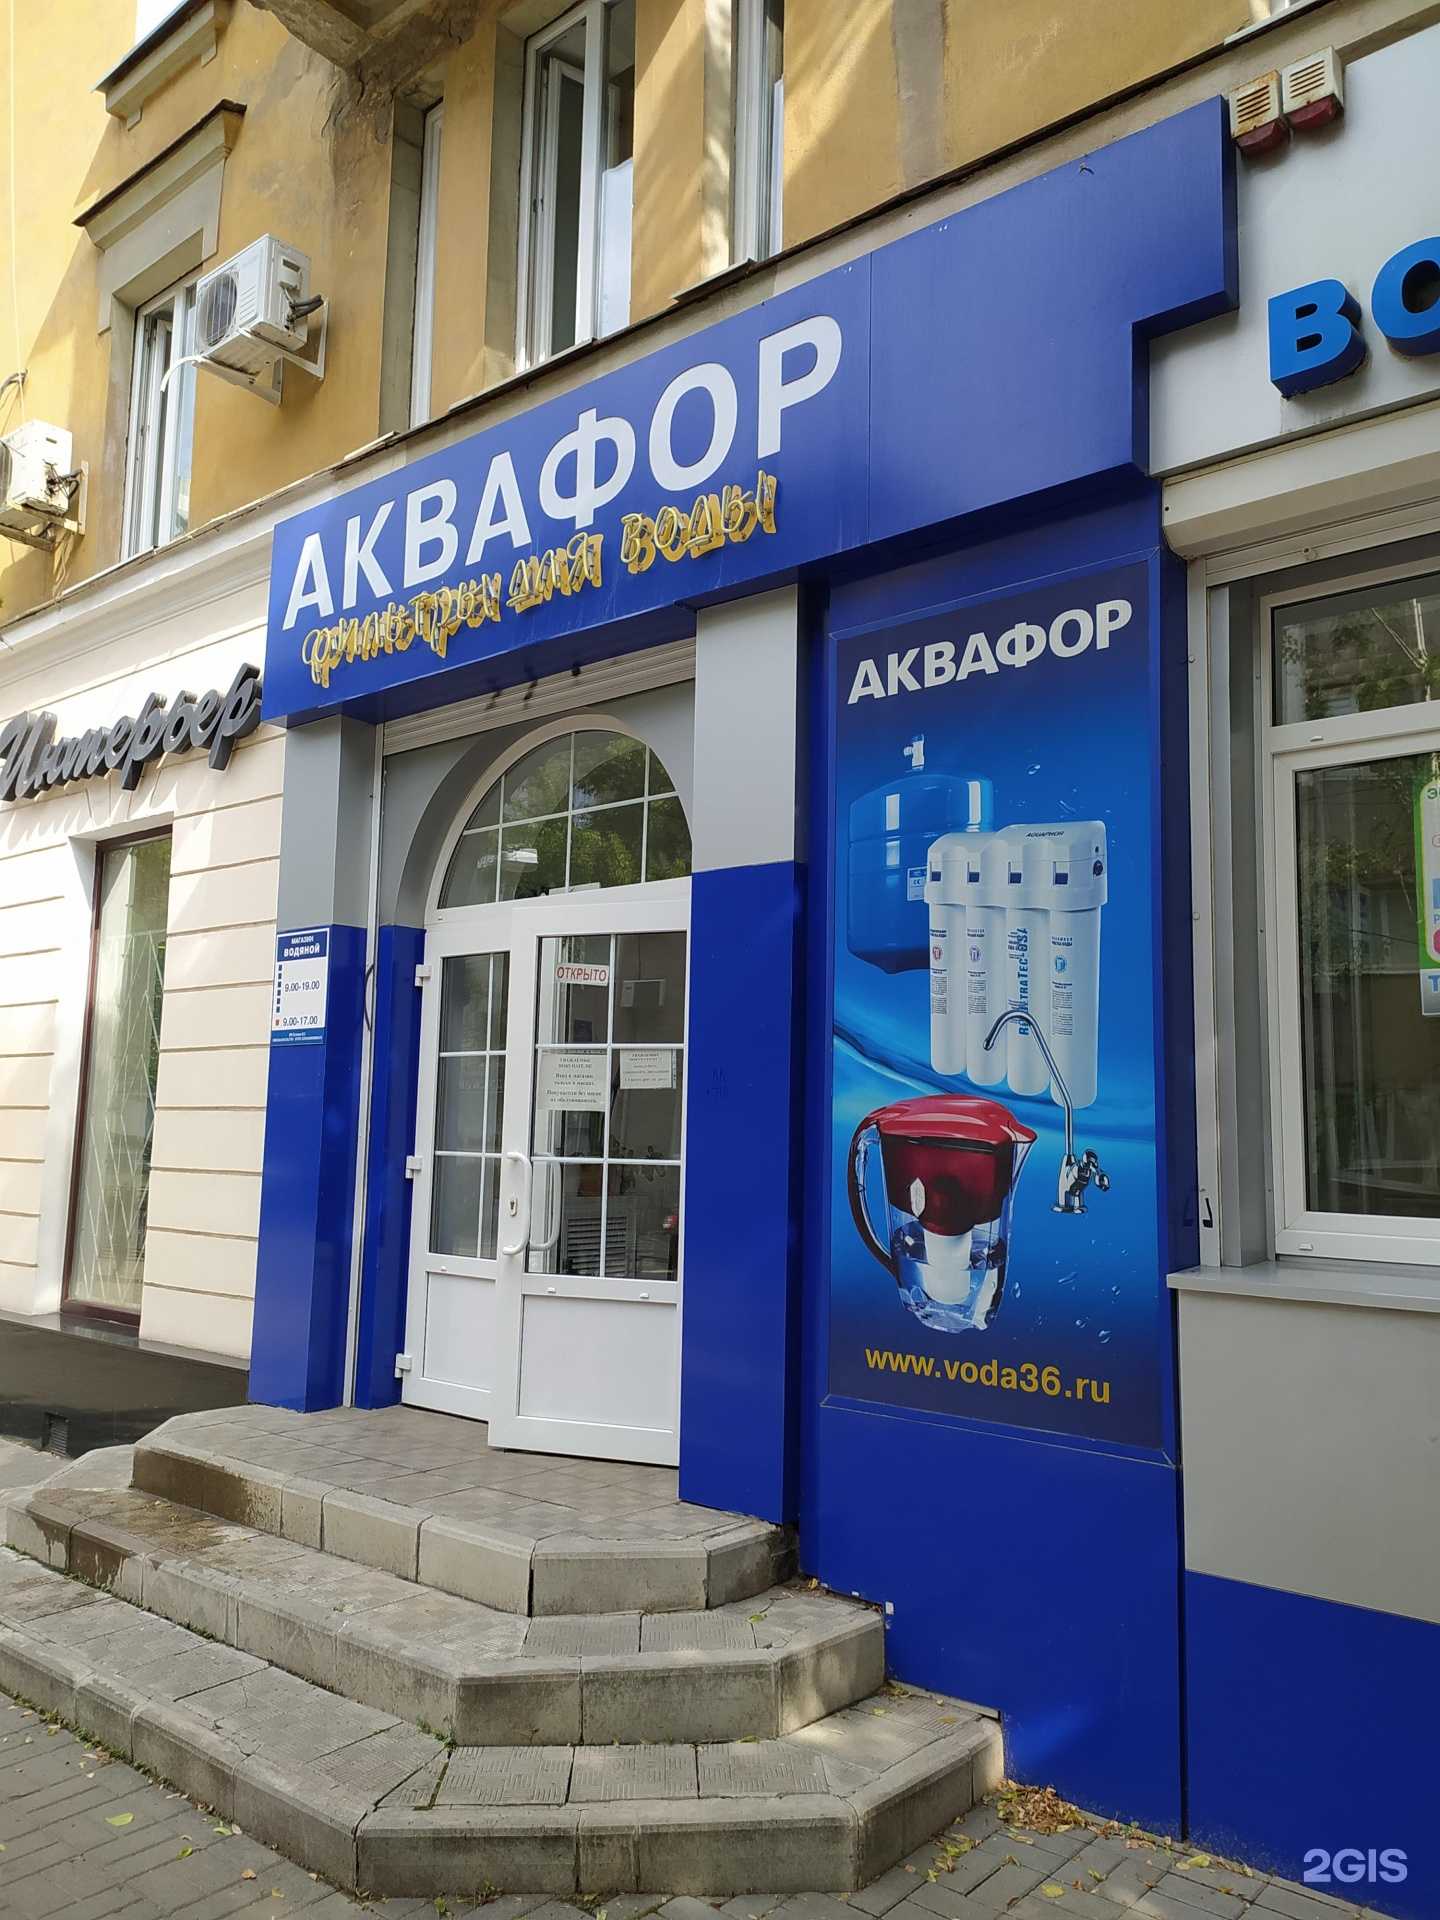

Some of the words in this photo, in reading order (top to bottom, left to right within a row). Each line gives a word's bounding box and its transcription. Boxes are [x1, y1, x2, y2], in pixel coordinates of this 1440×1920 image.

[282, 315, 843, 631] АКВАФОР
[847, 598, 1133, 705] АКВАФОР
[0, 662, 262, 802] Интерьер
[283, 943, 320, 958] ВОДЯНОЙ
[284, 980, 320, 993] 9.00-19.00
[556, 965, 607, 982] ОТКРЫТО
[282, 1015, 318, 1027] 9.00-17.00
[865, 1348, 1111, 1404] www.voda36.ru
